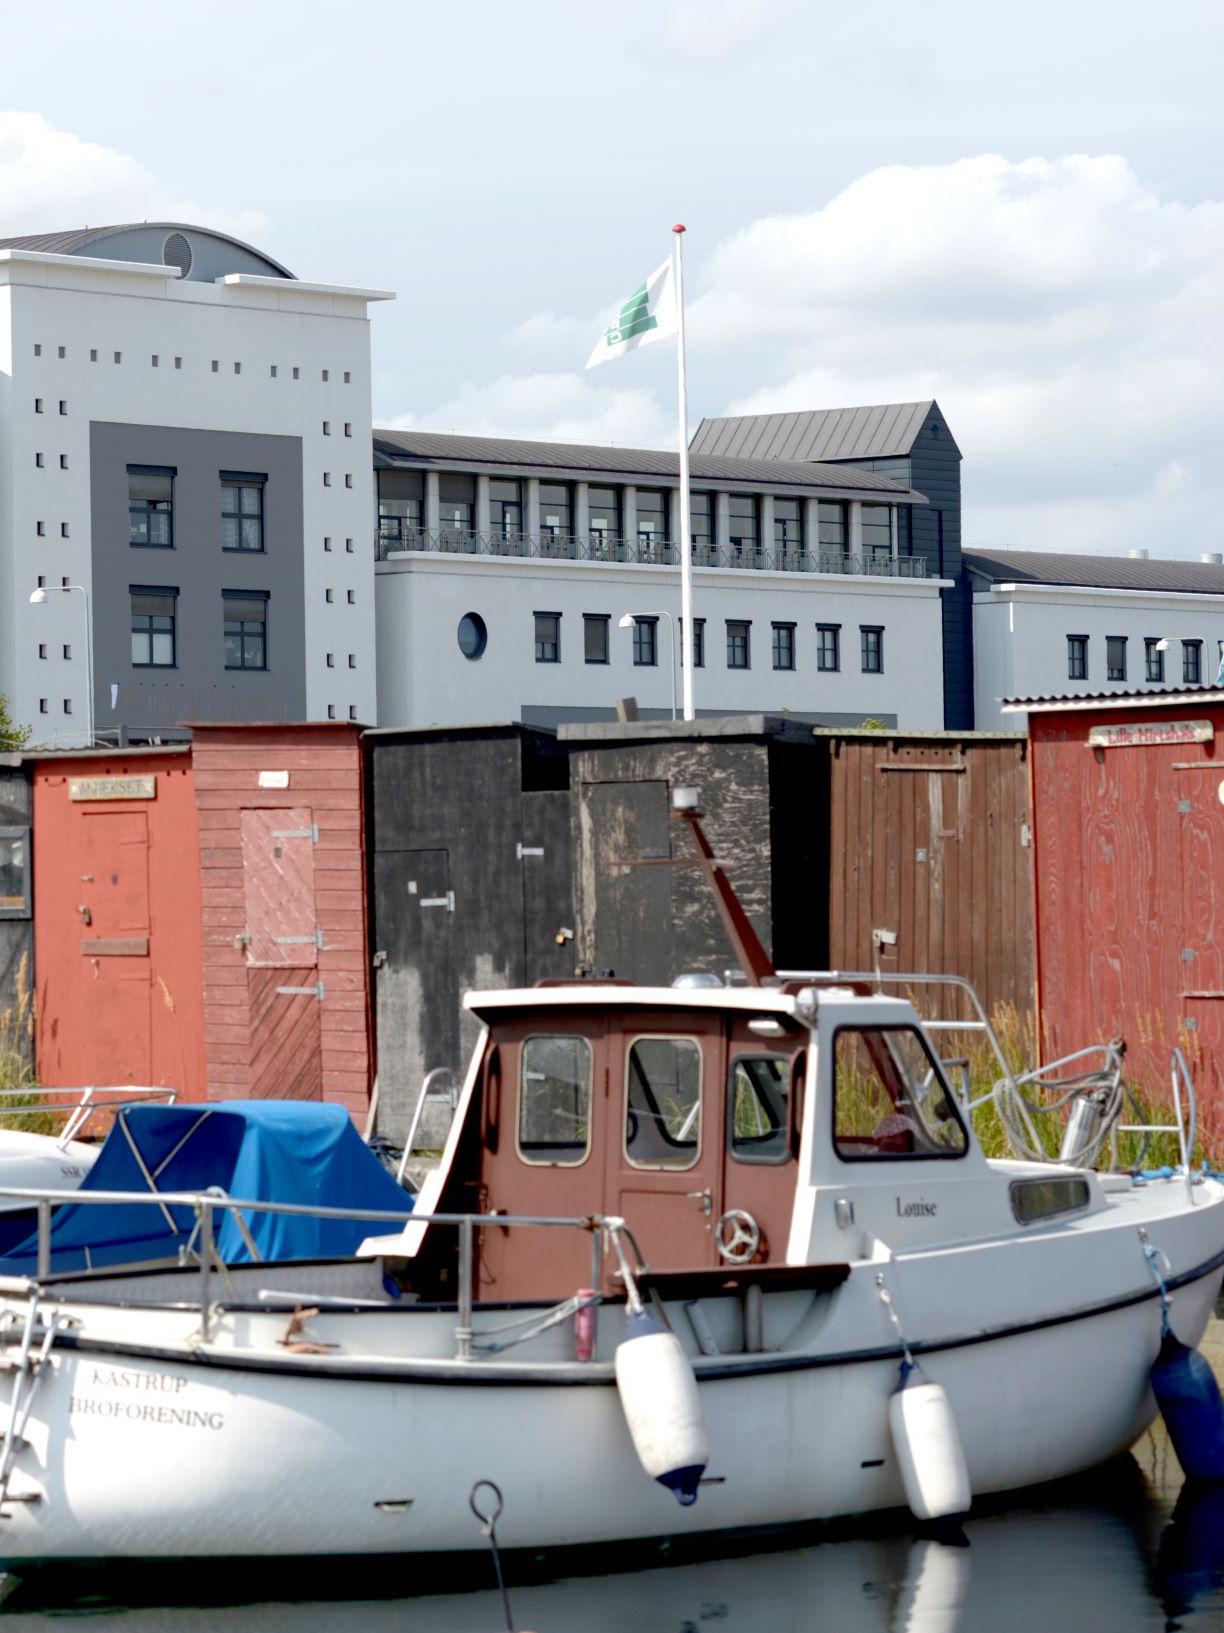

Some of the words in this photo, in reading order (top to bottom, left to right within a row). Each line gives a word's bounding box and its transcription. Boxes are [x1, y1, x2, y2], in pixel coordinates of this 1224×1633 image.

[895, 1196, 937, 1218] Louise
[92, 1368, 189, 1394] KASTRUP
[68, 1396, 224, 1430] BROFORENING
